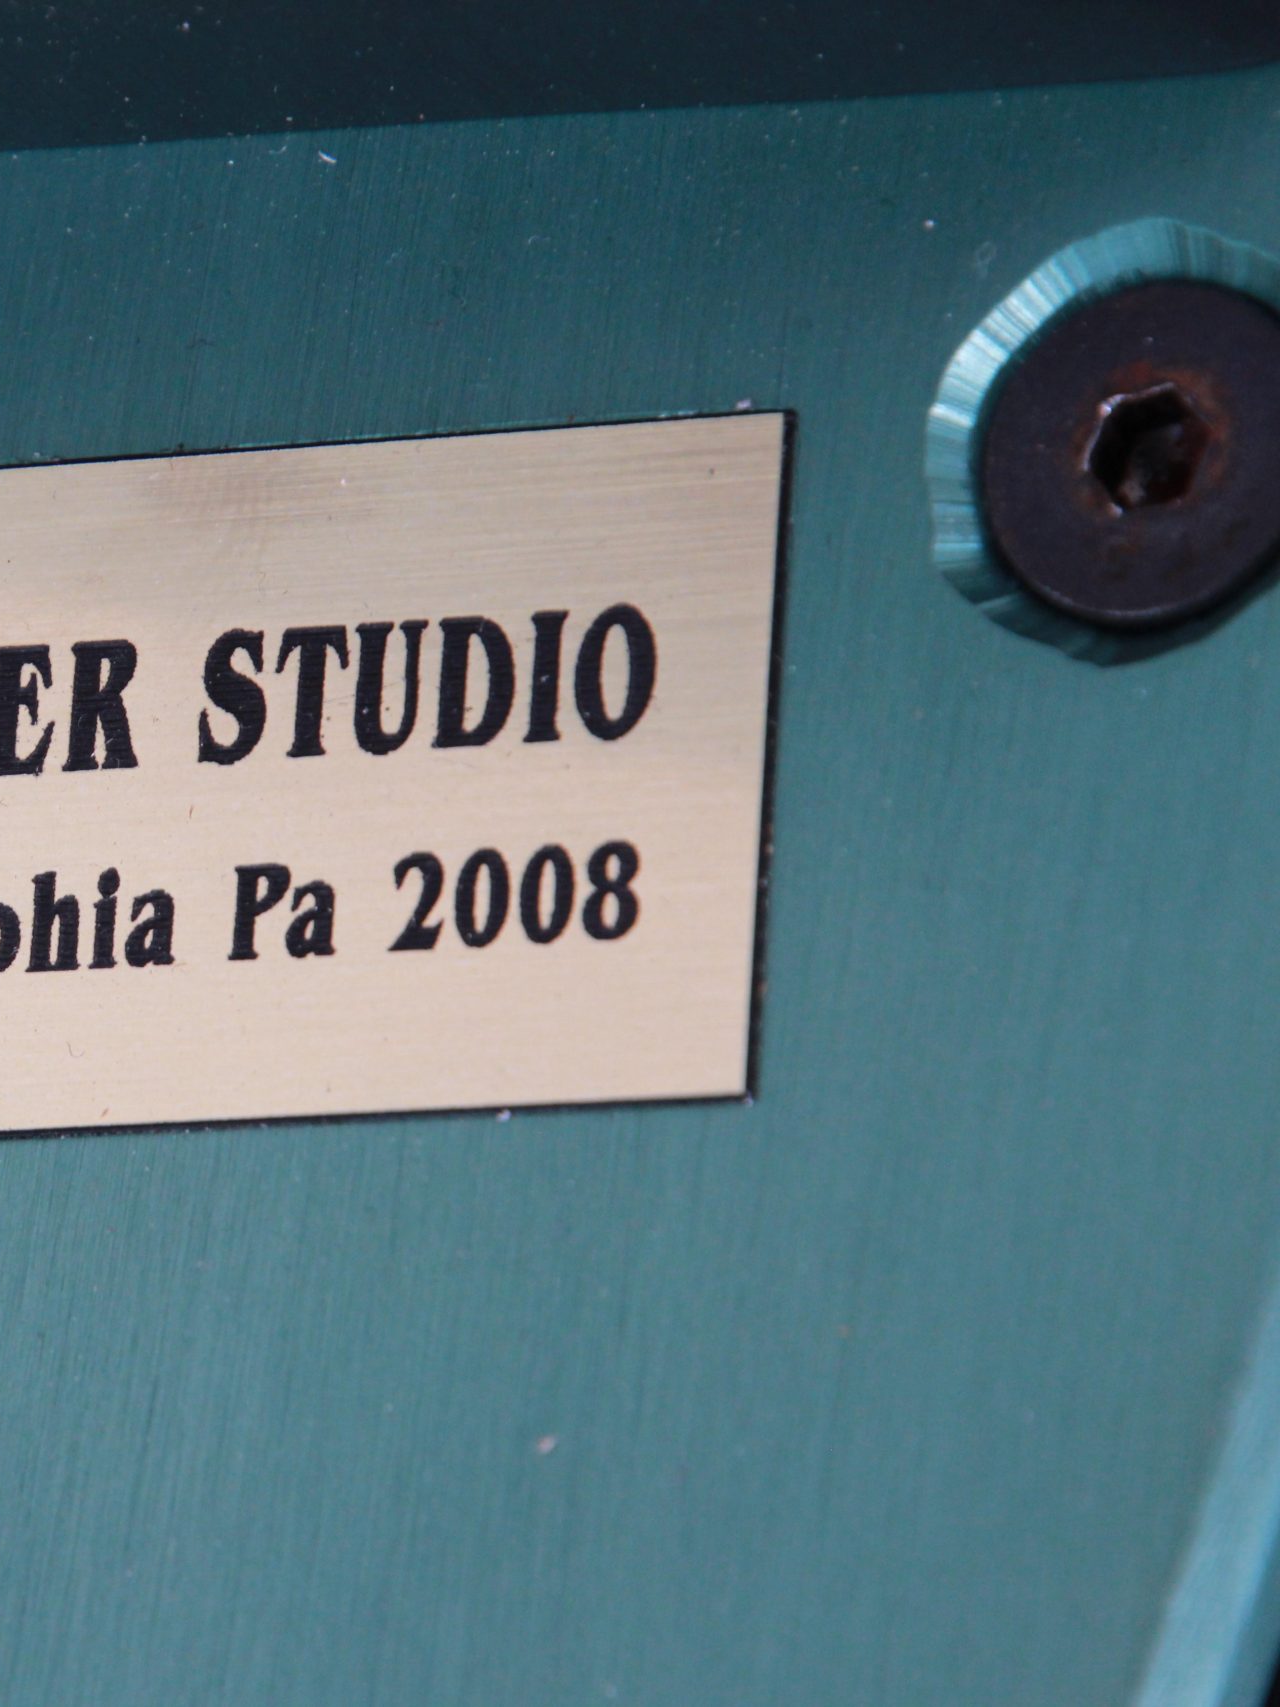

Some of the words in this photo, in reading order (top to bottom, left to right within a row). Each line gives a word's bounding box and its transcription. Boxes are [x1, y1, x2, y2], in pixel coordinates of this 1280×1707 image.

[198, 604, 656, 766] STUDIO
[228, 864, 335, 960] Pa
[389, 842, 639, 953] 2008
